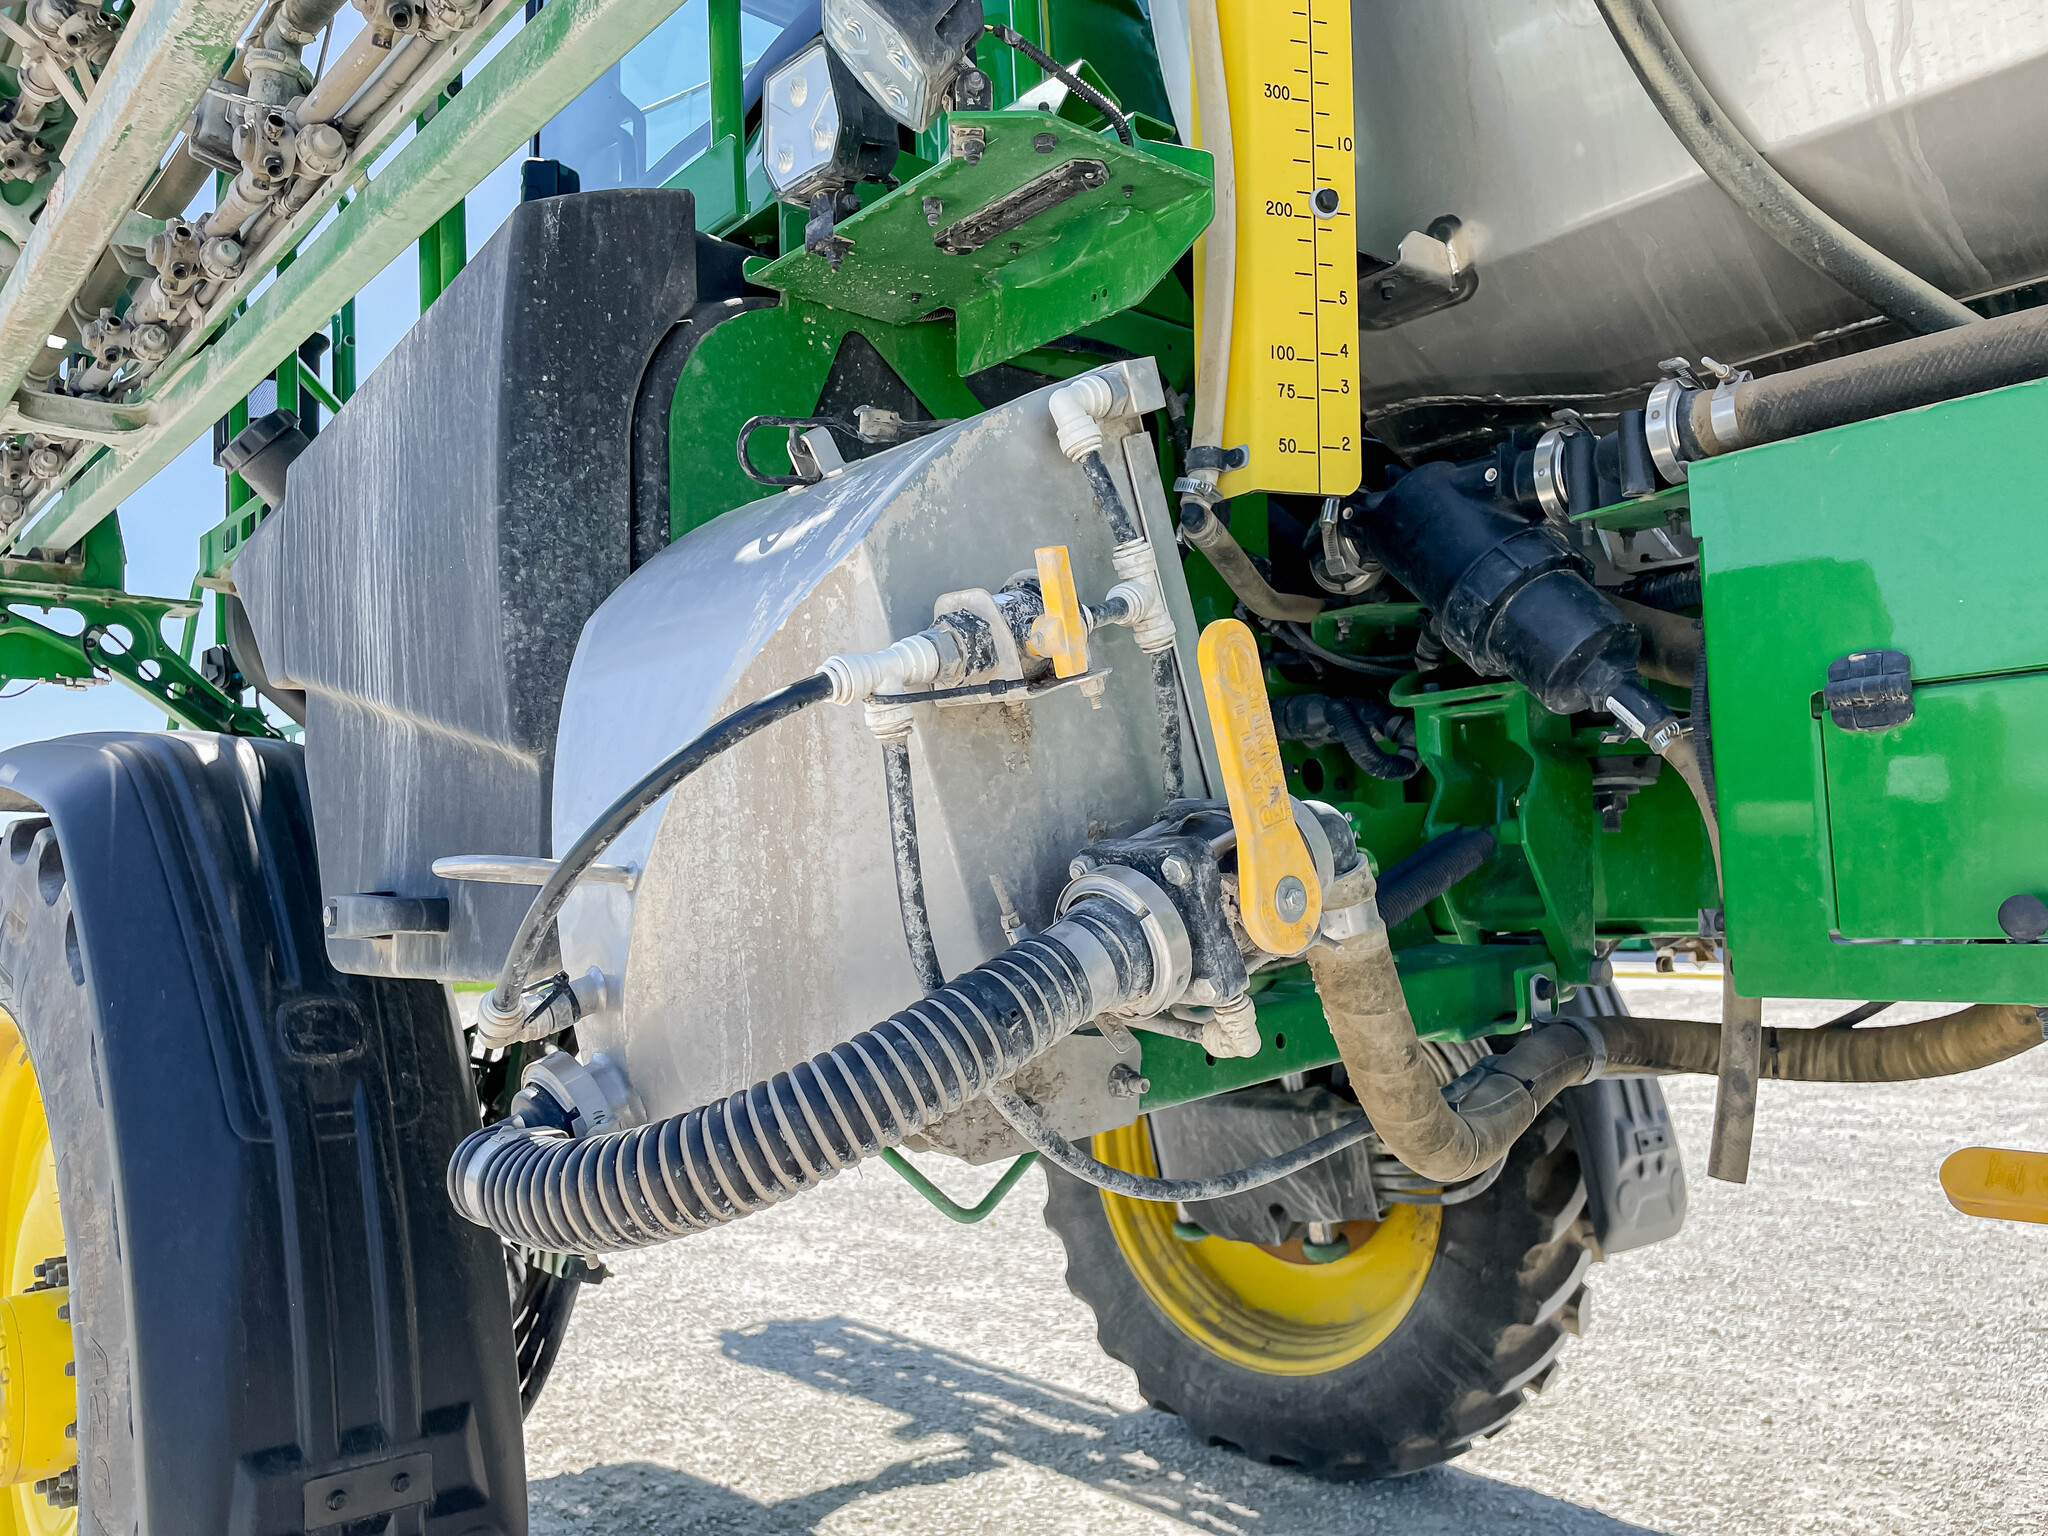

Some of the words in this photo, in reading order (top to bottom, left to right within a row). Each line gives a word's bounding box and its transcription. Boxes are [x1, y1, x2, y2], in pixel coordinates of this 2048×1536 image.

[1264, 83, 1290, 101] 300
[1337, 136, 1353, 152] 10
[1265, 200, 1293, 218] 200
[1339, 290, 1348, 306] 5
[1270, 344, 1295, 361] 100
[1339, 343, 1349, 359] 4
[1277, 383, 1296, 399] 75
[1339, 379, 1350, 395] 3
[1278, 437, 1297, 454] 50
[1340, 436, 1351, 452] 2
